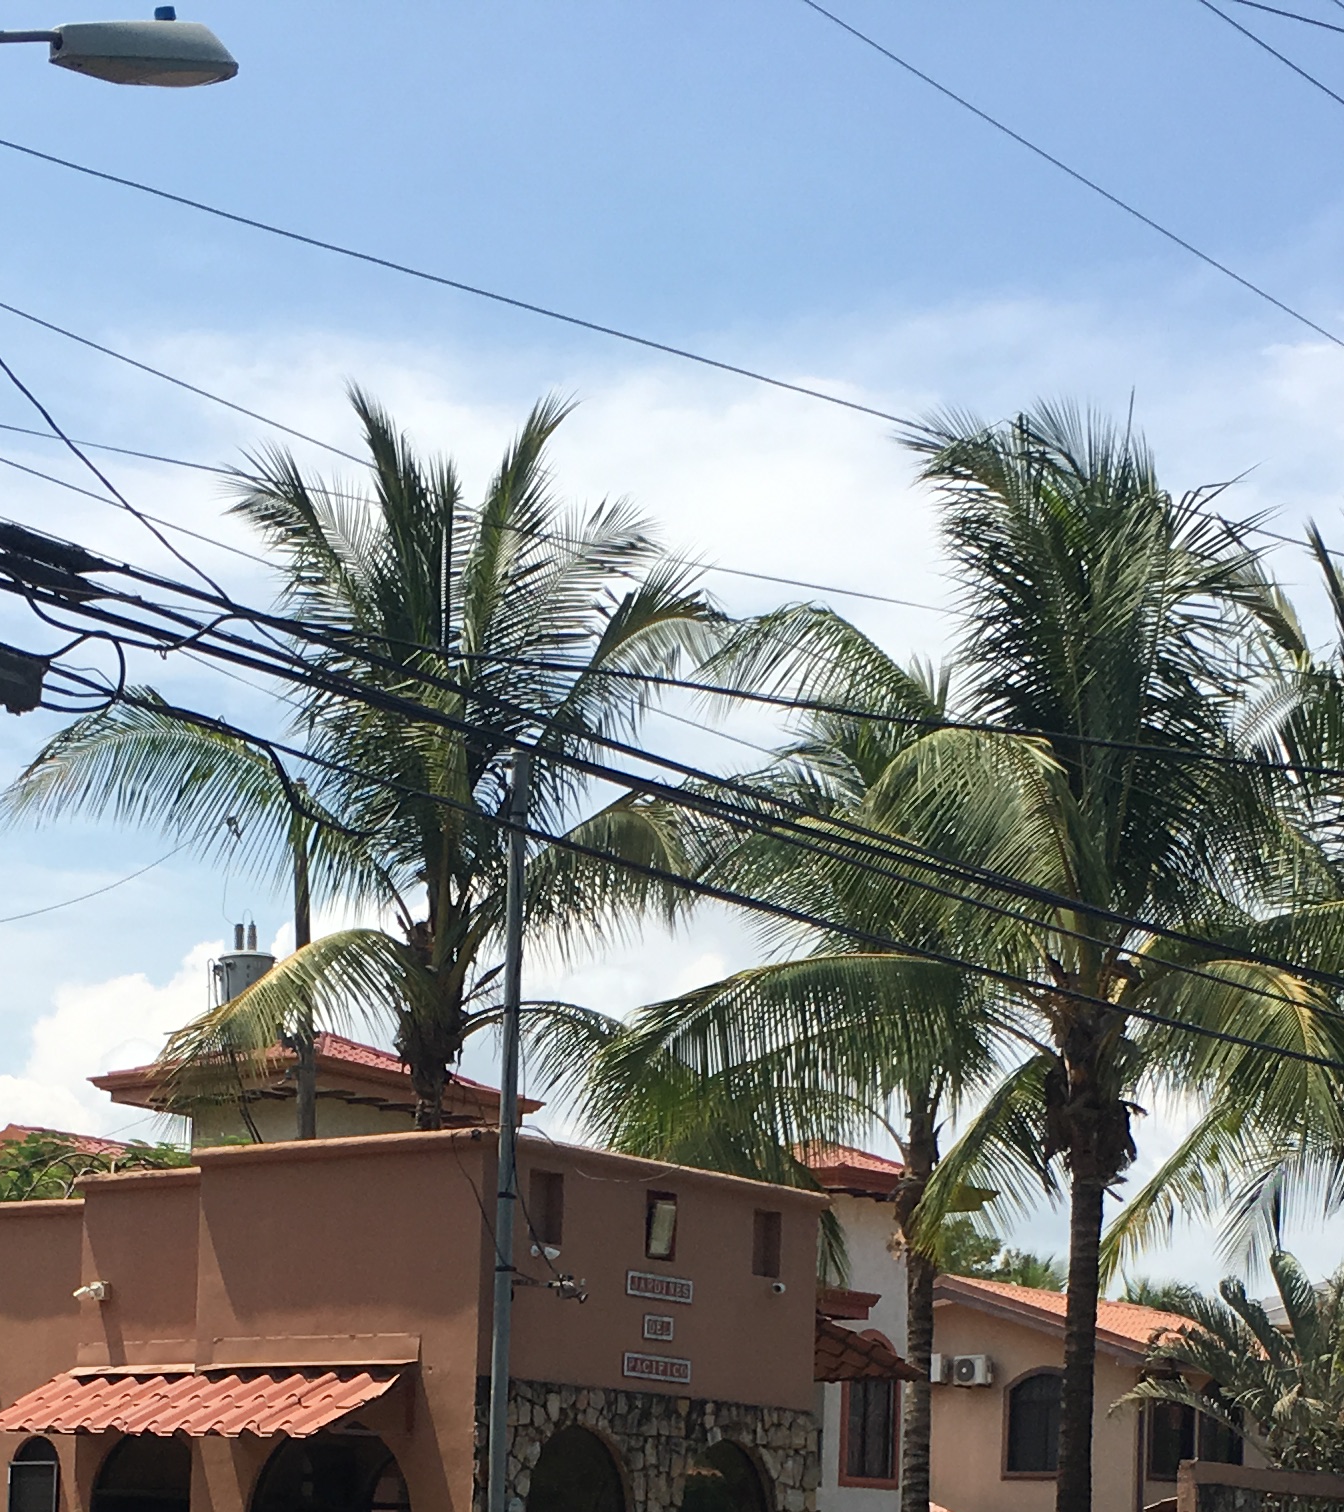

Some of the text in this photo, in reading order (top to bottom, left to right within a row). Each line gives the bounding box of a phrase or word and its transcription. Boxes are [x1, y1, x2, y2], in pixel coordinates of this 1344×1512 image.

[631, 1277, 689, 1297] JARDINES
[648, 1321, 670, 1335] DEL
[628, 1359, 687, 1377] PACIFICO
